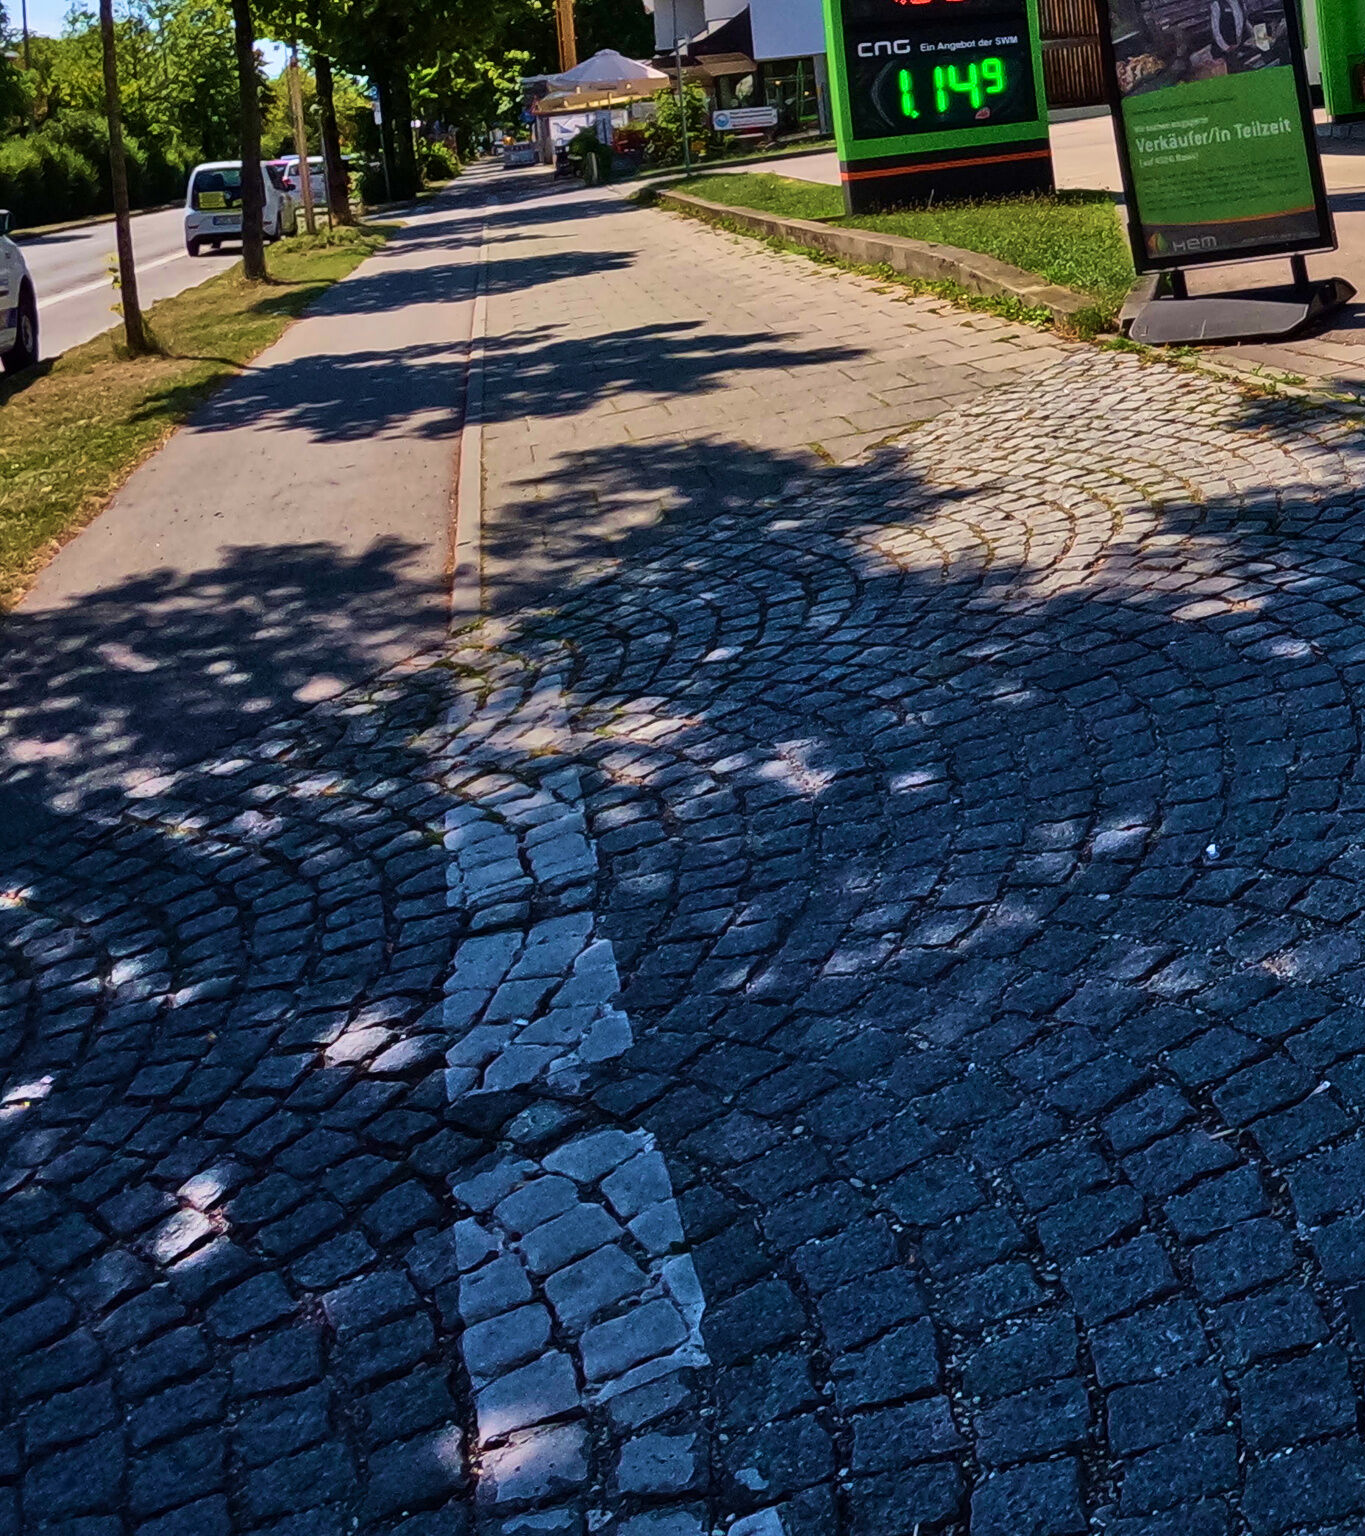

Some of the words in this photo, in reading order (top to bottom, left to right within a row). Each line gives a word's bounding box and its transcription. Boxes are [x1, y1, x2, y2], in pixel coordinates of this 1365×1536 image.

[857, 39, 911, 57] CNG
[919, 42, 935, 52] Ein
[937, 40, 976, 53] Angebot
[978, 38, 993, 48] der
[1233, 117, 1292, 139] Teilzeit
